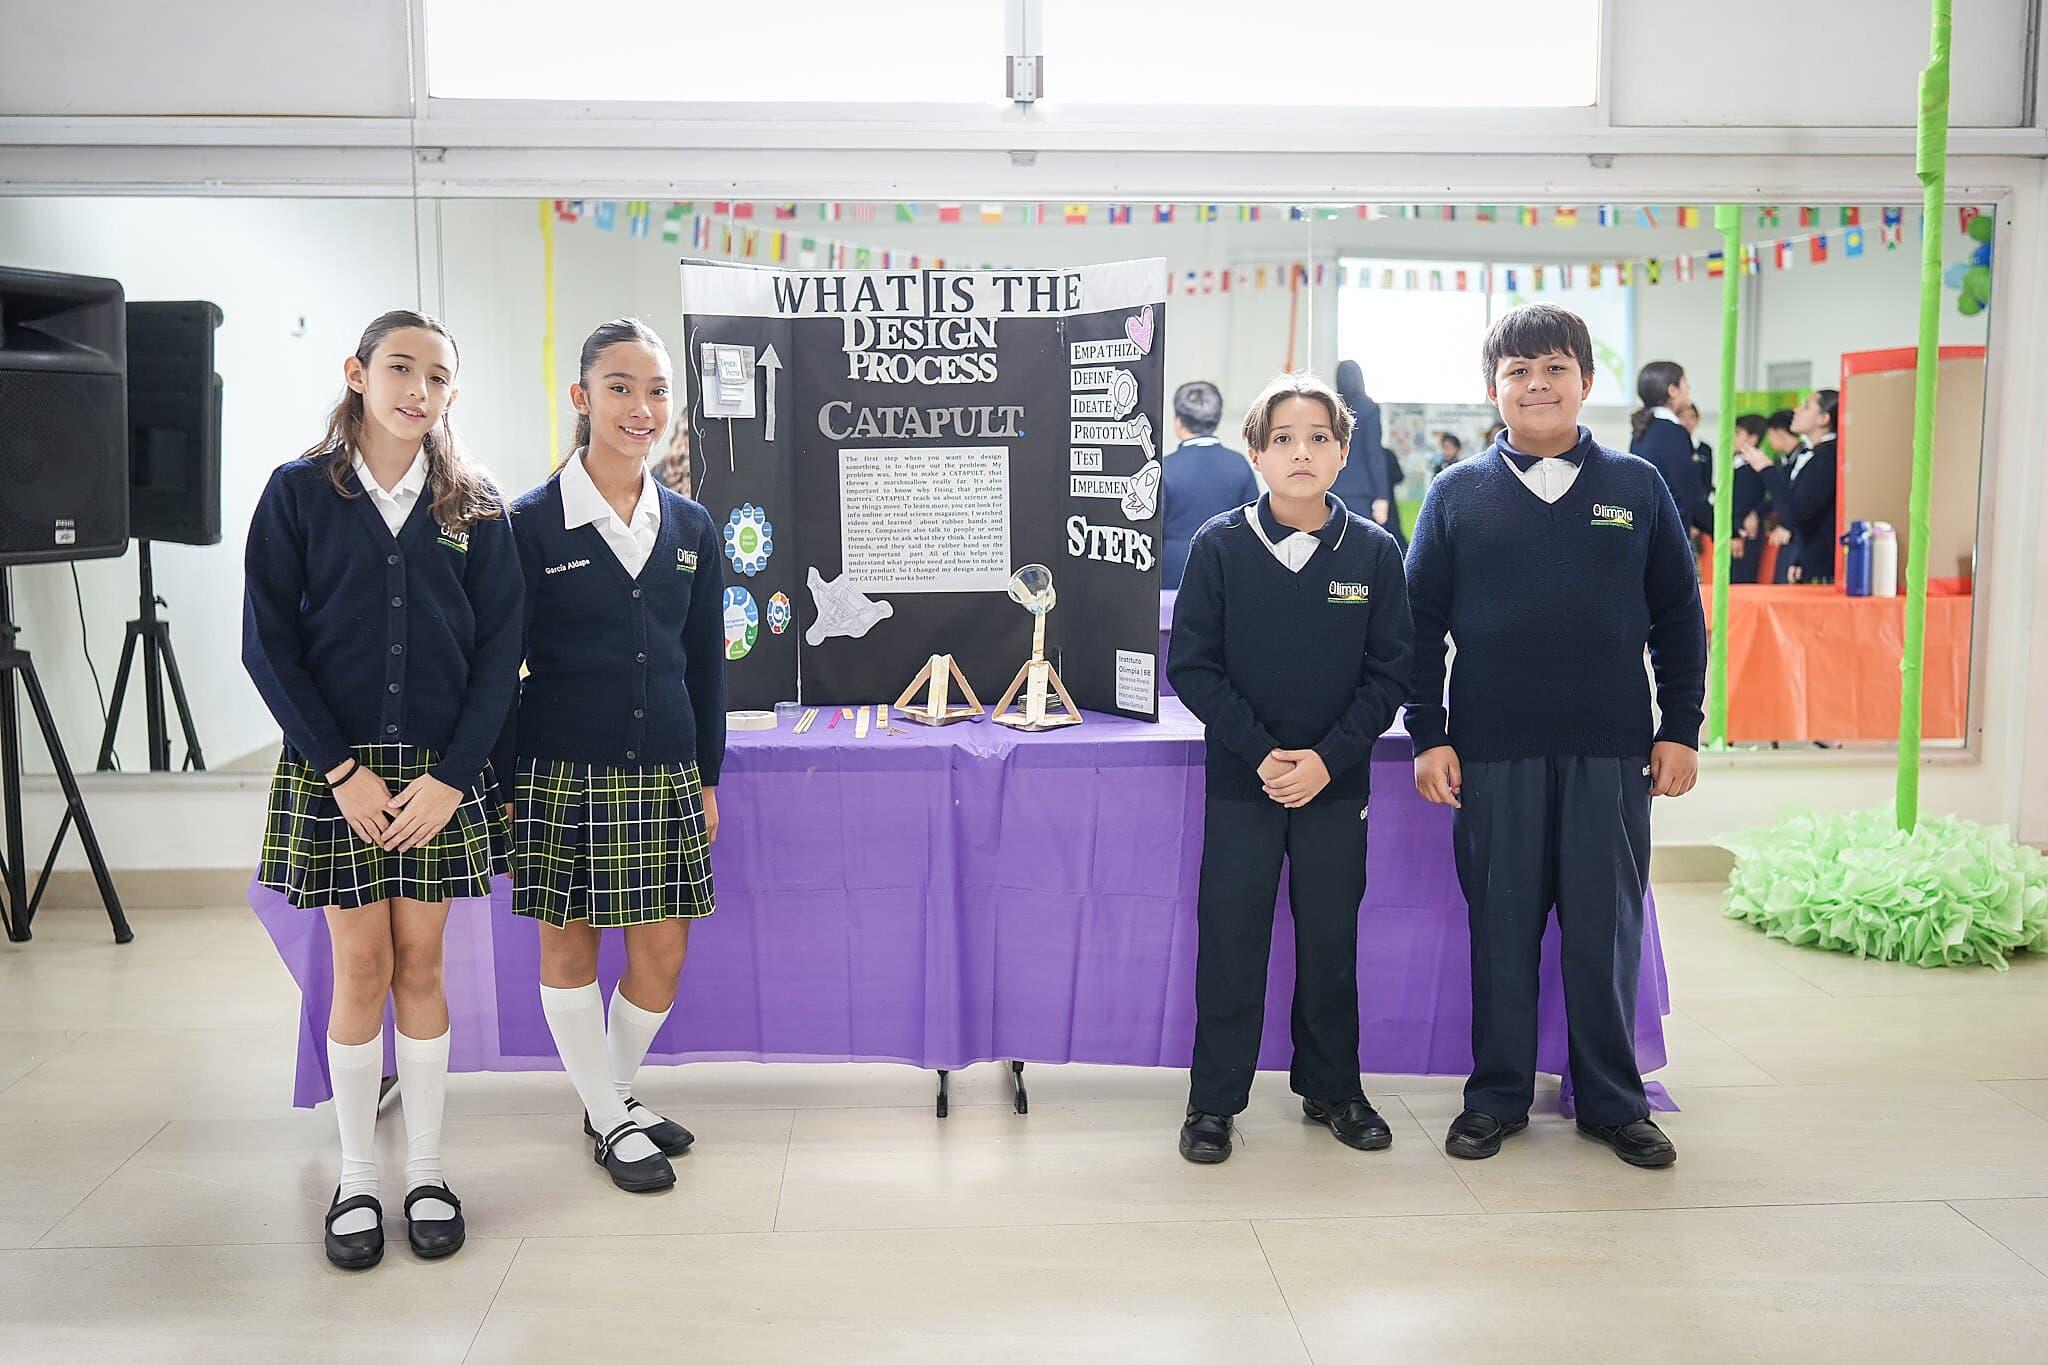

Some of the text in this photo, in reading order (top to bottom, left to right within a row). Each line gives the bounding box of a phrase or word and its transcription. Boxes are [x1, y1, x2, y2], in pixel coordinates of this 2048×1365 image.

[773, 273, 1082, 313] WHAT IS THE
[842, 315, 998, 351] DESIGN
[1074, 343, 1140, 360] EMPATHIZE
[848, 351, 997, 384] PROCESS
[1074, 399, 1112, 414] IDEATE
[818, 401, 1024, 440] CATAPULT
[1074, 425, 1129, 440] PROTOTY
[1074, 451, 1100, 466] TEST
[846, 471, 873, 479] problem
[932, 478, 951, 486] really
[916, 486, 930, 494] why
[1073, 479, 1129, 494] IMPLEMEN
[862, 503, 882, 511] things
[1593, 503, 1633, 522] Olimpia
[931, 534, 945, 542] they
[1066, 515, 1153, 572] STEPS
[970, 549, 987, 557] helps
[904, 558, 926, 566] people
[913, 566, 939, 574] changed
[1328, 580, 1369, 596] Olimpia
[1119, 656, 1142, 664] Instituto
[1119, 665, 1140, 675] Olimpia
